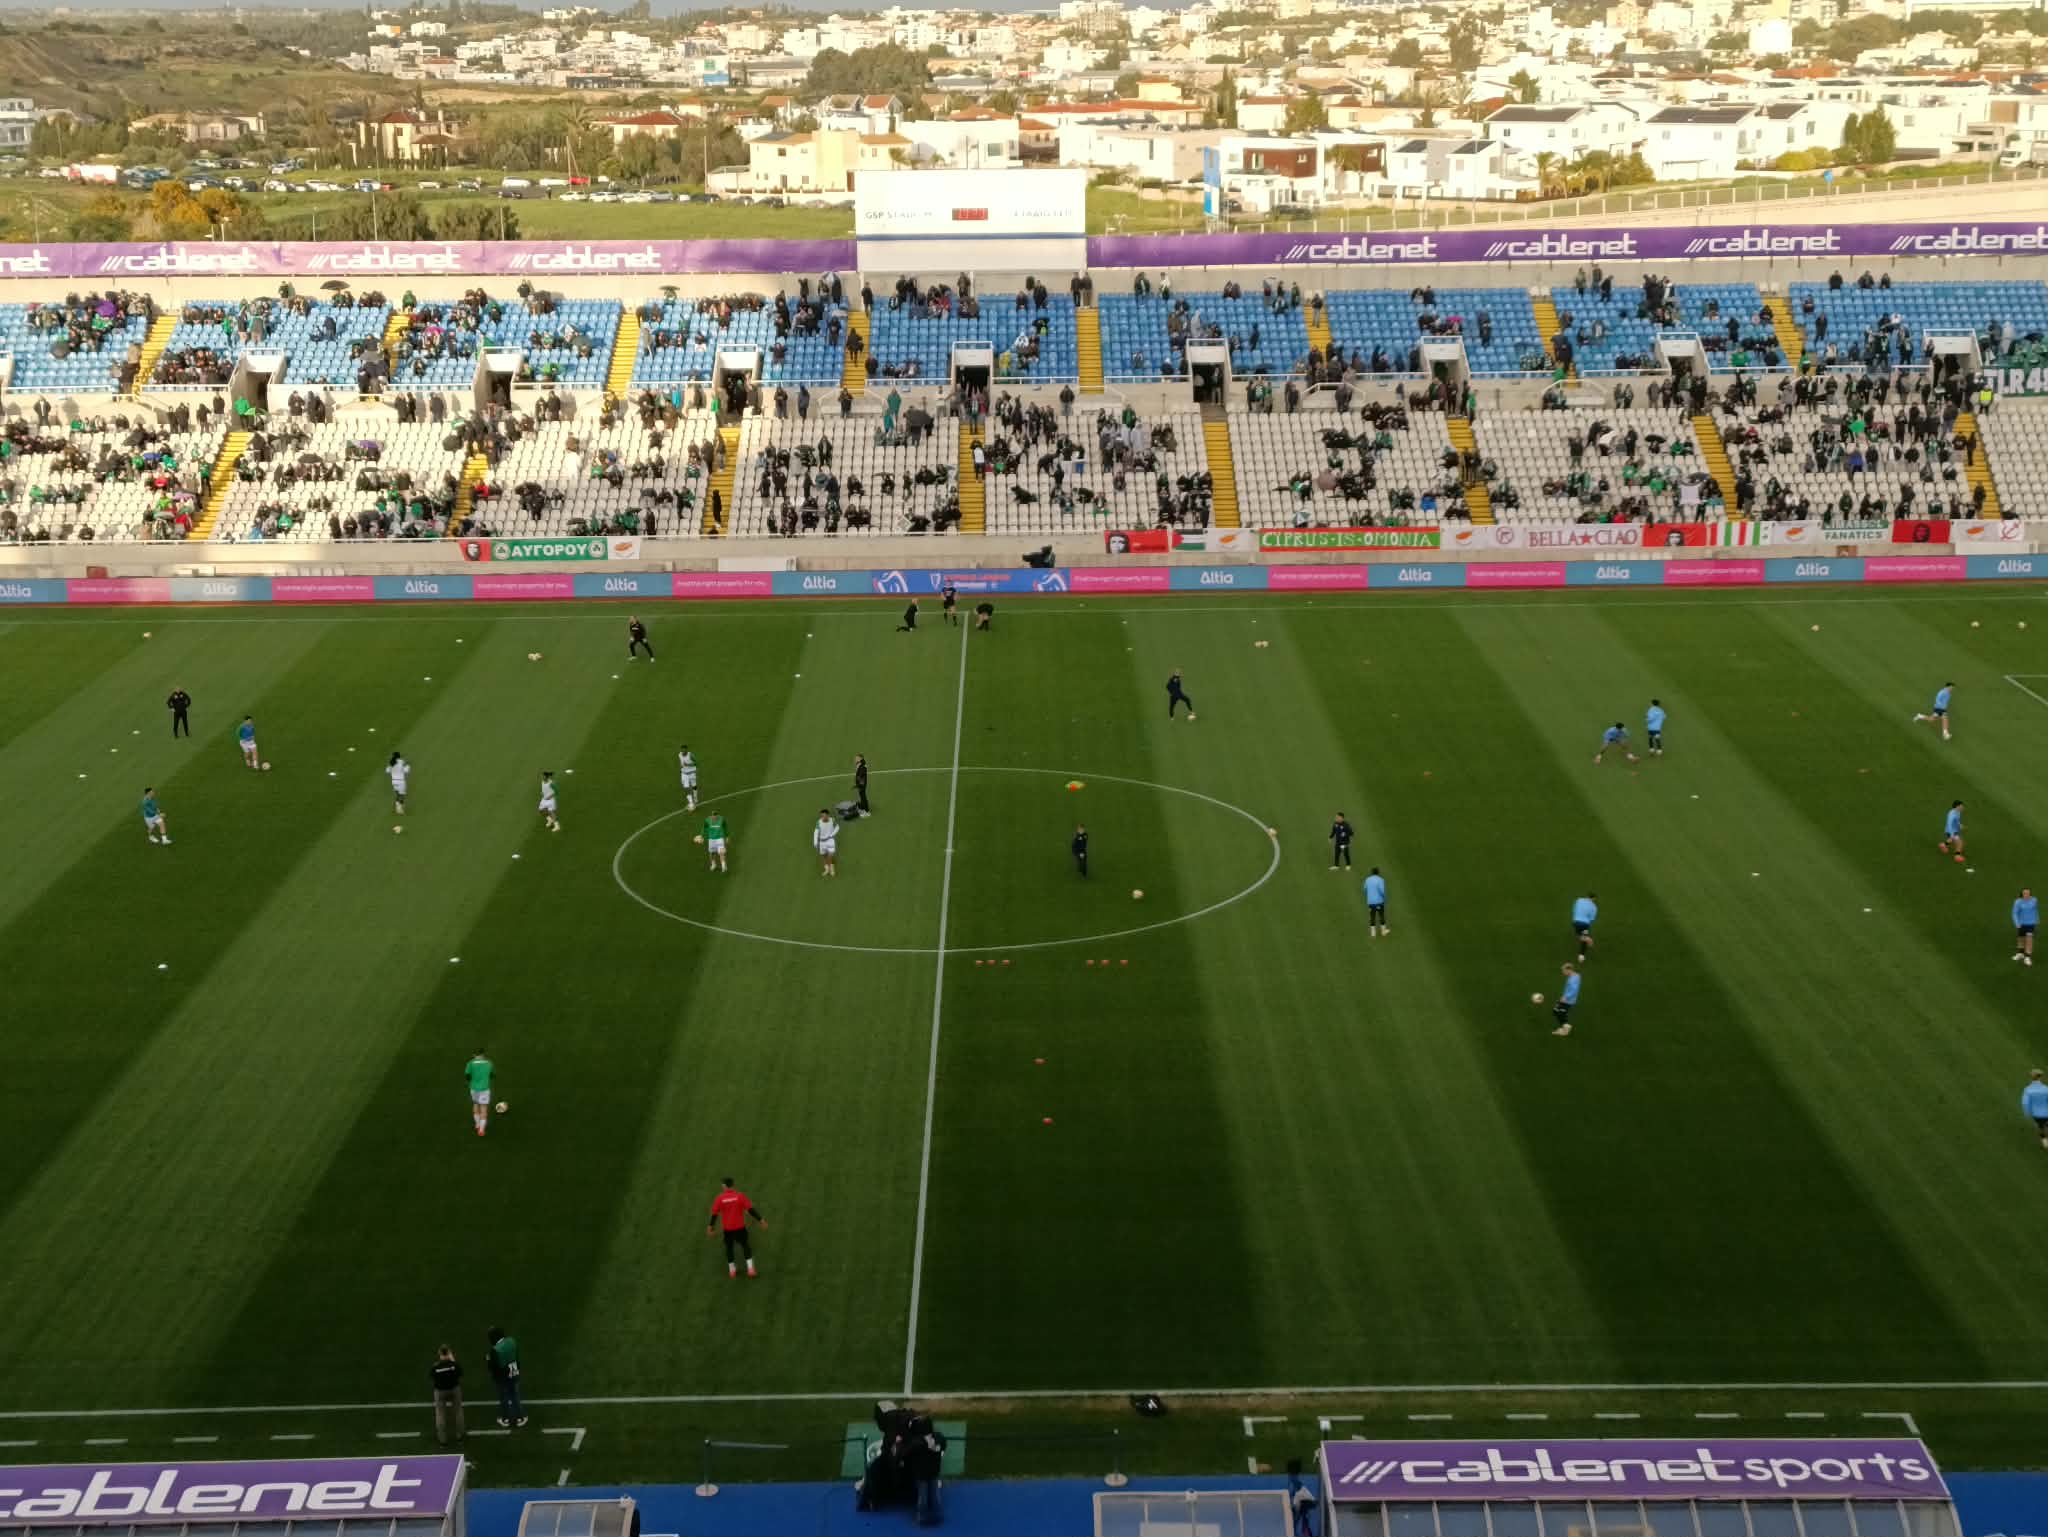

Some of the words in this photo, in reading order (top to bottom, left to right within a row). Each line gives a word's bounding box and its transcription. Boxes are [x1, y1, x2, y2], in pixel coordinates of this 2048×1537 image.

[1508, 233, 1638, 257] cablenet
[1708, 229, 1841, 252] cablenet
[1309, 236, 1438, 260] cablenet
[125, 247, 257, 271] cablenet
[330, 246, 461, 270] cablenet
[532, 245, 662, 269] cablenet
[1528, 530, 1579, 547] BELLA
[1595, 528, 1638, 545] CIAO
[1824, 530, 1883, 541] FANATICS
[511, 543, 586, 558] ΑΥΓΟΡΟΥ
[1596, 566, 1631, 580] Altia
[1795, 563, 1830, 577] Altia
[1997, 560, 2032, 574] Altia
[1200, 572, 1234, 585] Altia
[1398, 568, 1432, 582] Altia
[405, 581, 439, 594] Altia
[604, 578, 638, 592] Altia
[803, 576, 837, 590] Altia
[1401, 1448, 1742, 1482] cablenet
[1744, 1453, 1930, 1488] sports
